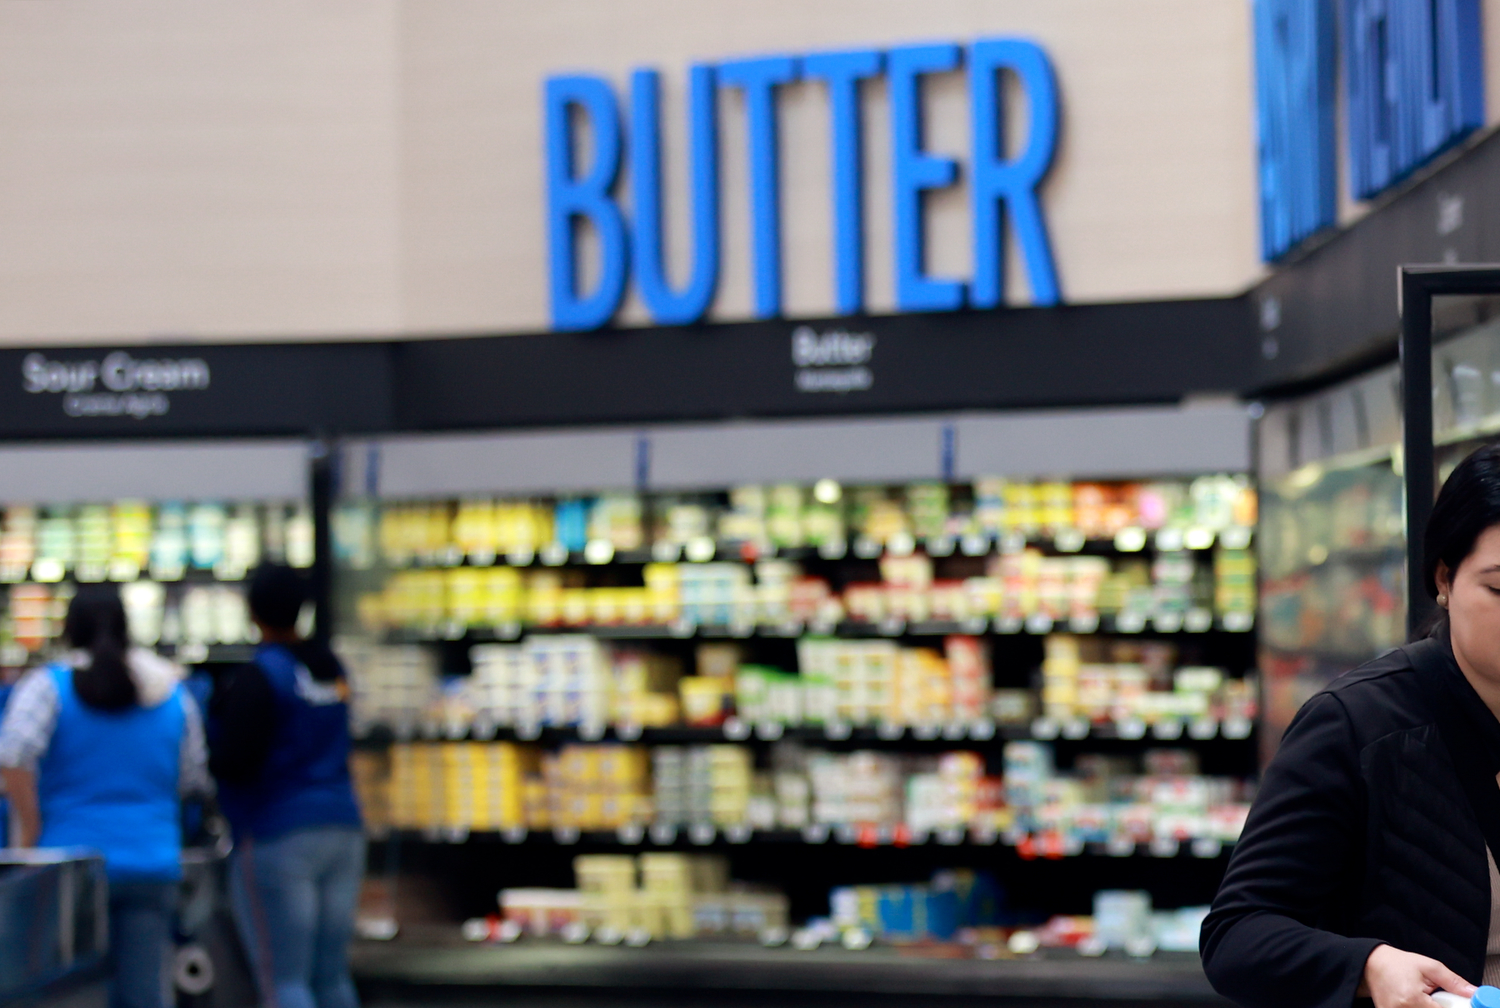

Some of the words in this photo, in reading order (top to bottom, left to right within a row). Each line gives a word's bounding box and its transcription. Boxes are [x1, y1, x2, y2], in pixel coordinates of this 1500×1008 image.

[543, 38, 1064, 332] BUTTER
[792, 327, 876, 366] Butter
[23, 353, 96, 392] Sour
[101, 351, 209, 391] Cream
